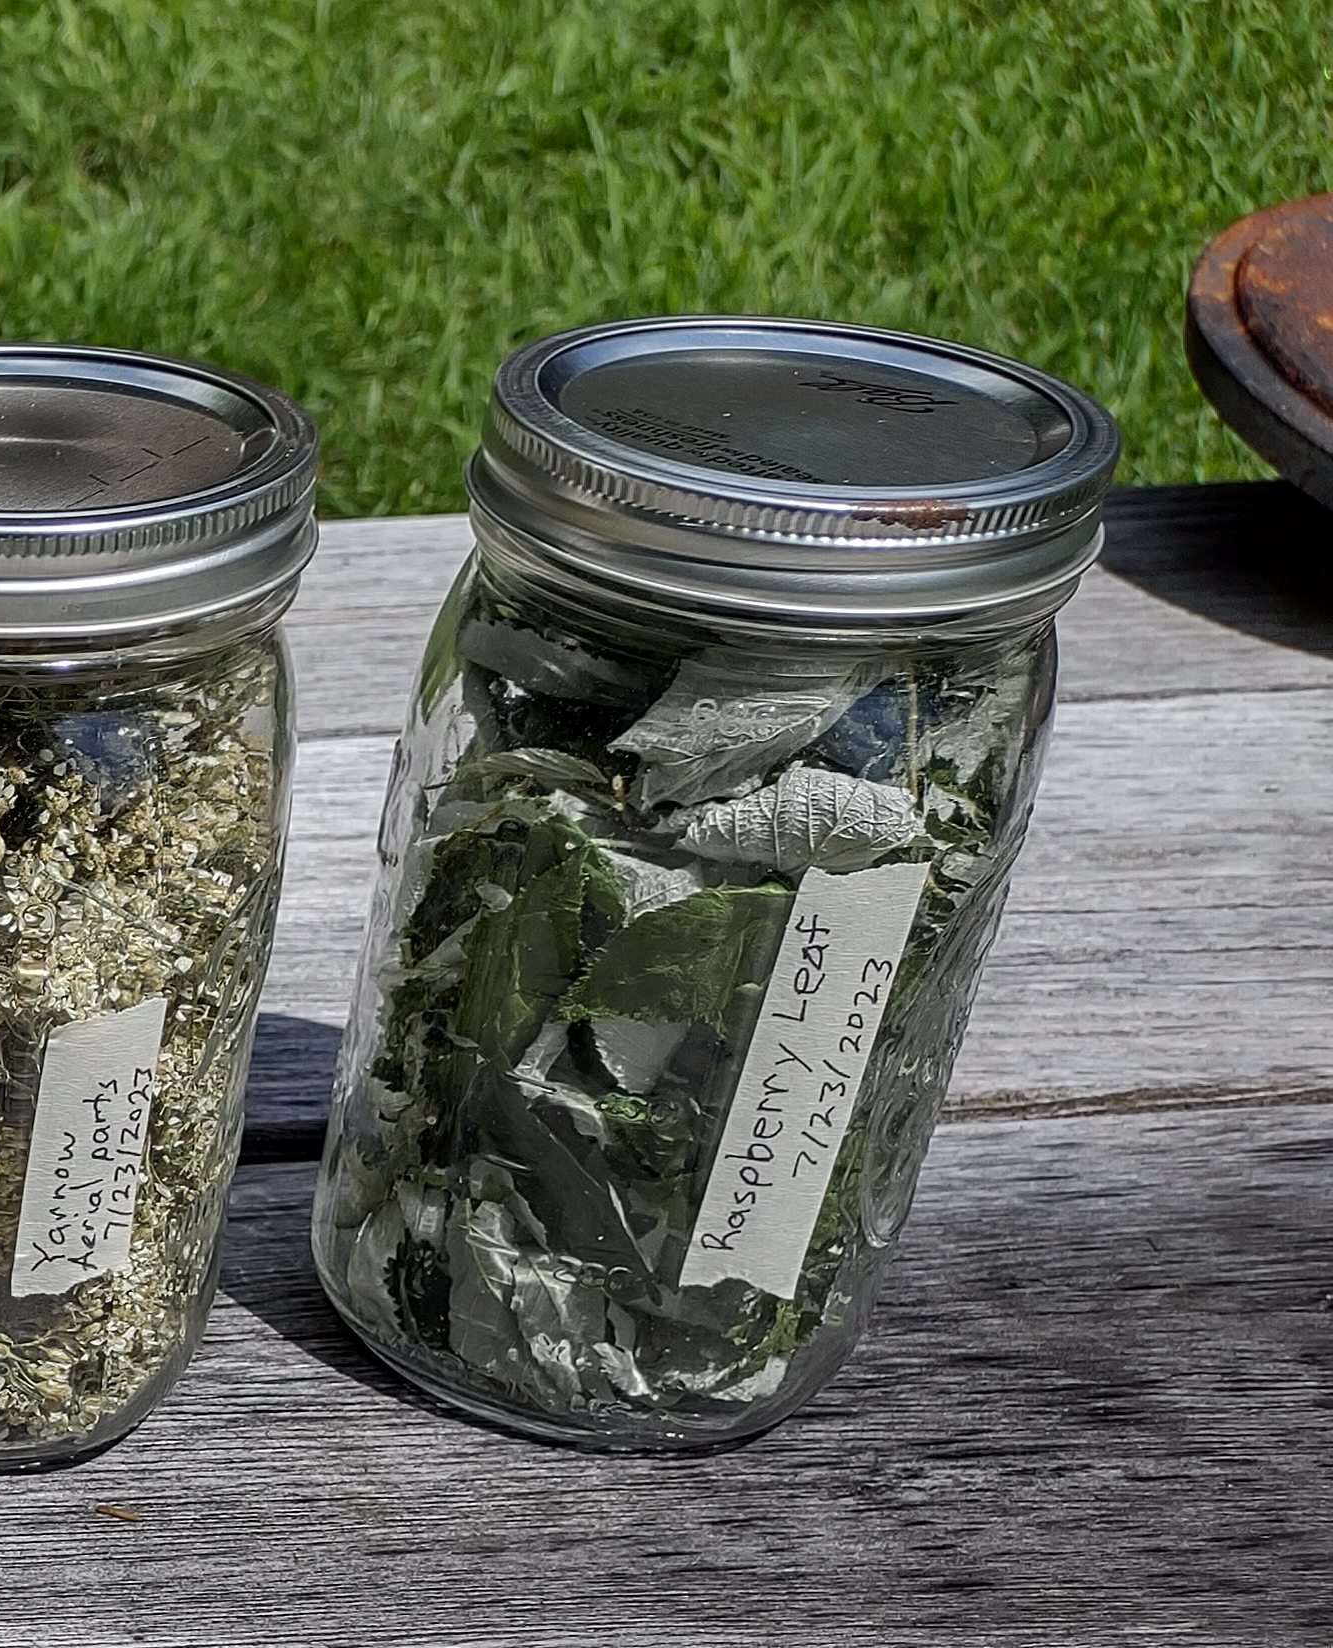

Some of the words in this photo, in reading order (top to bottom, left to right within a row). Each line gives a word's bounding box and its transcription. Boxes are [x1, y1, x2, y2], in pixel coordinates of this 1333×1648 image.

[798, 372, 959, 413] Ball
[82, 1080, 119, 1162] parts
[700, 1040, 813, 1251] Raspberry
[770, 913, 830, 1023] Leaf
[791, 957, 893, 1178] 7/23/2023
[102, 1067, 152, 1240] 7/23/2023
[68, 1178, 104, 1271] Aerial
